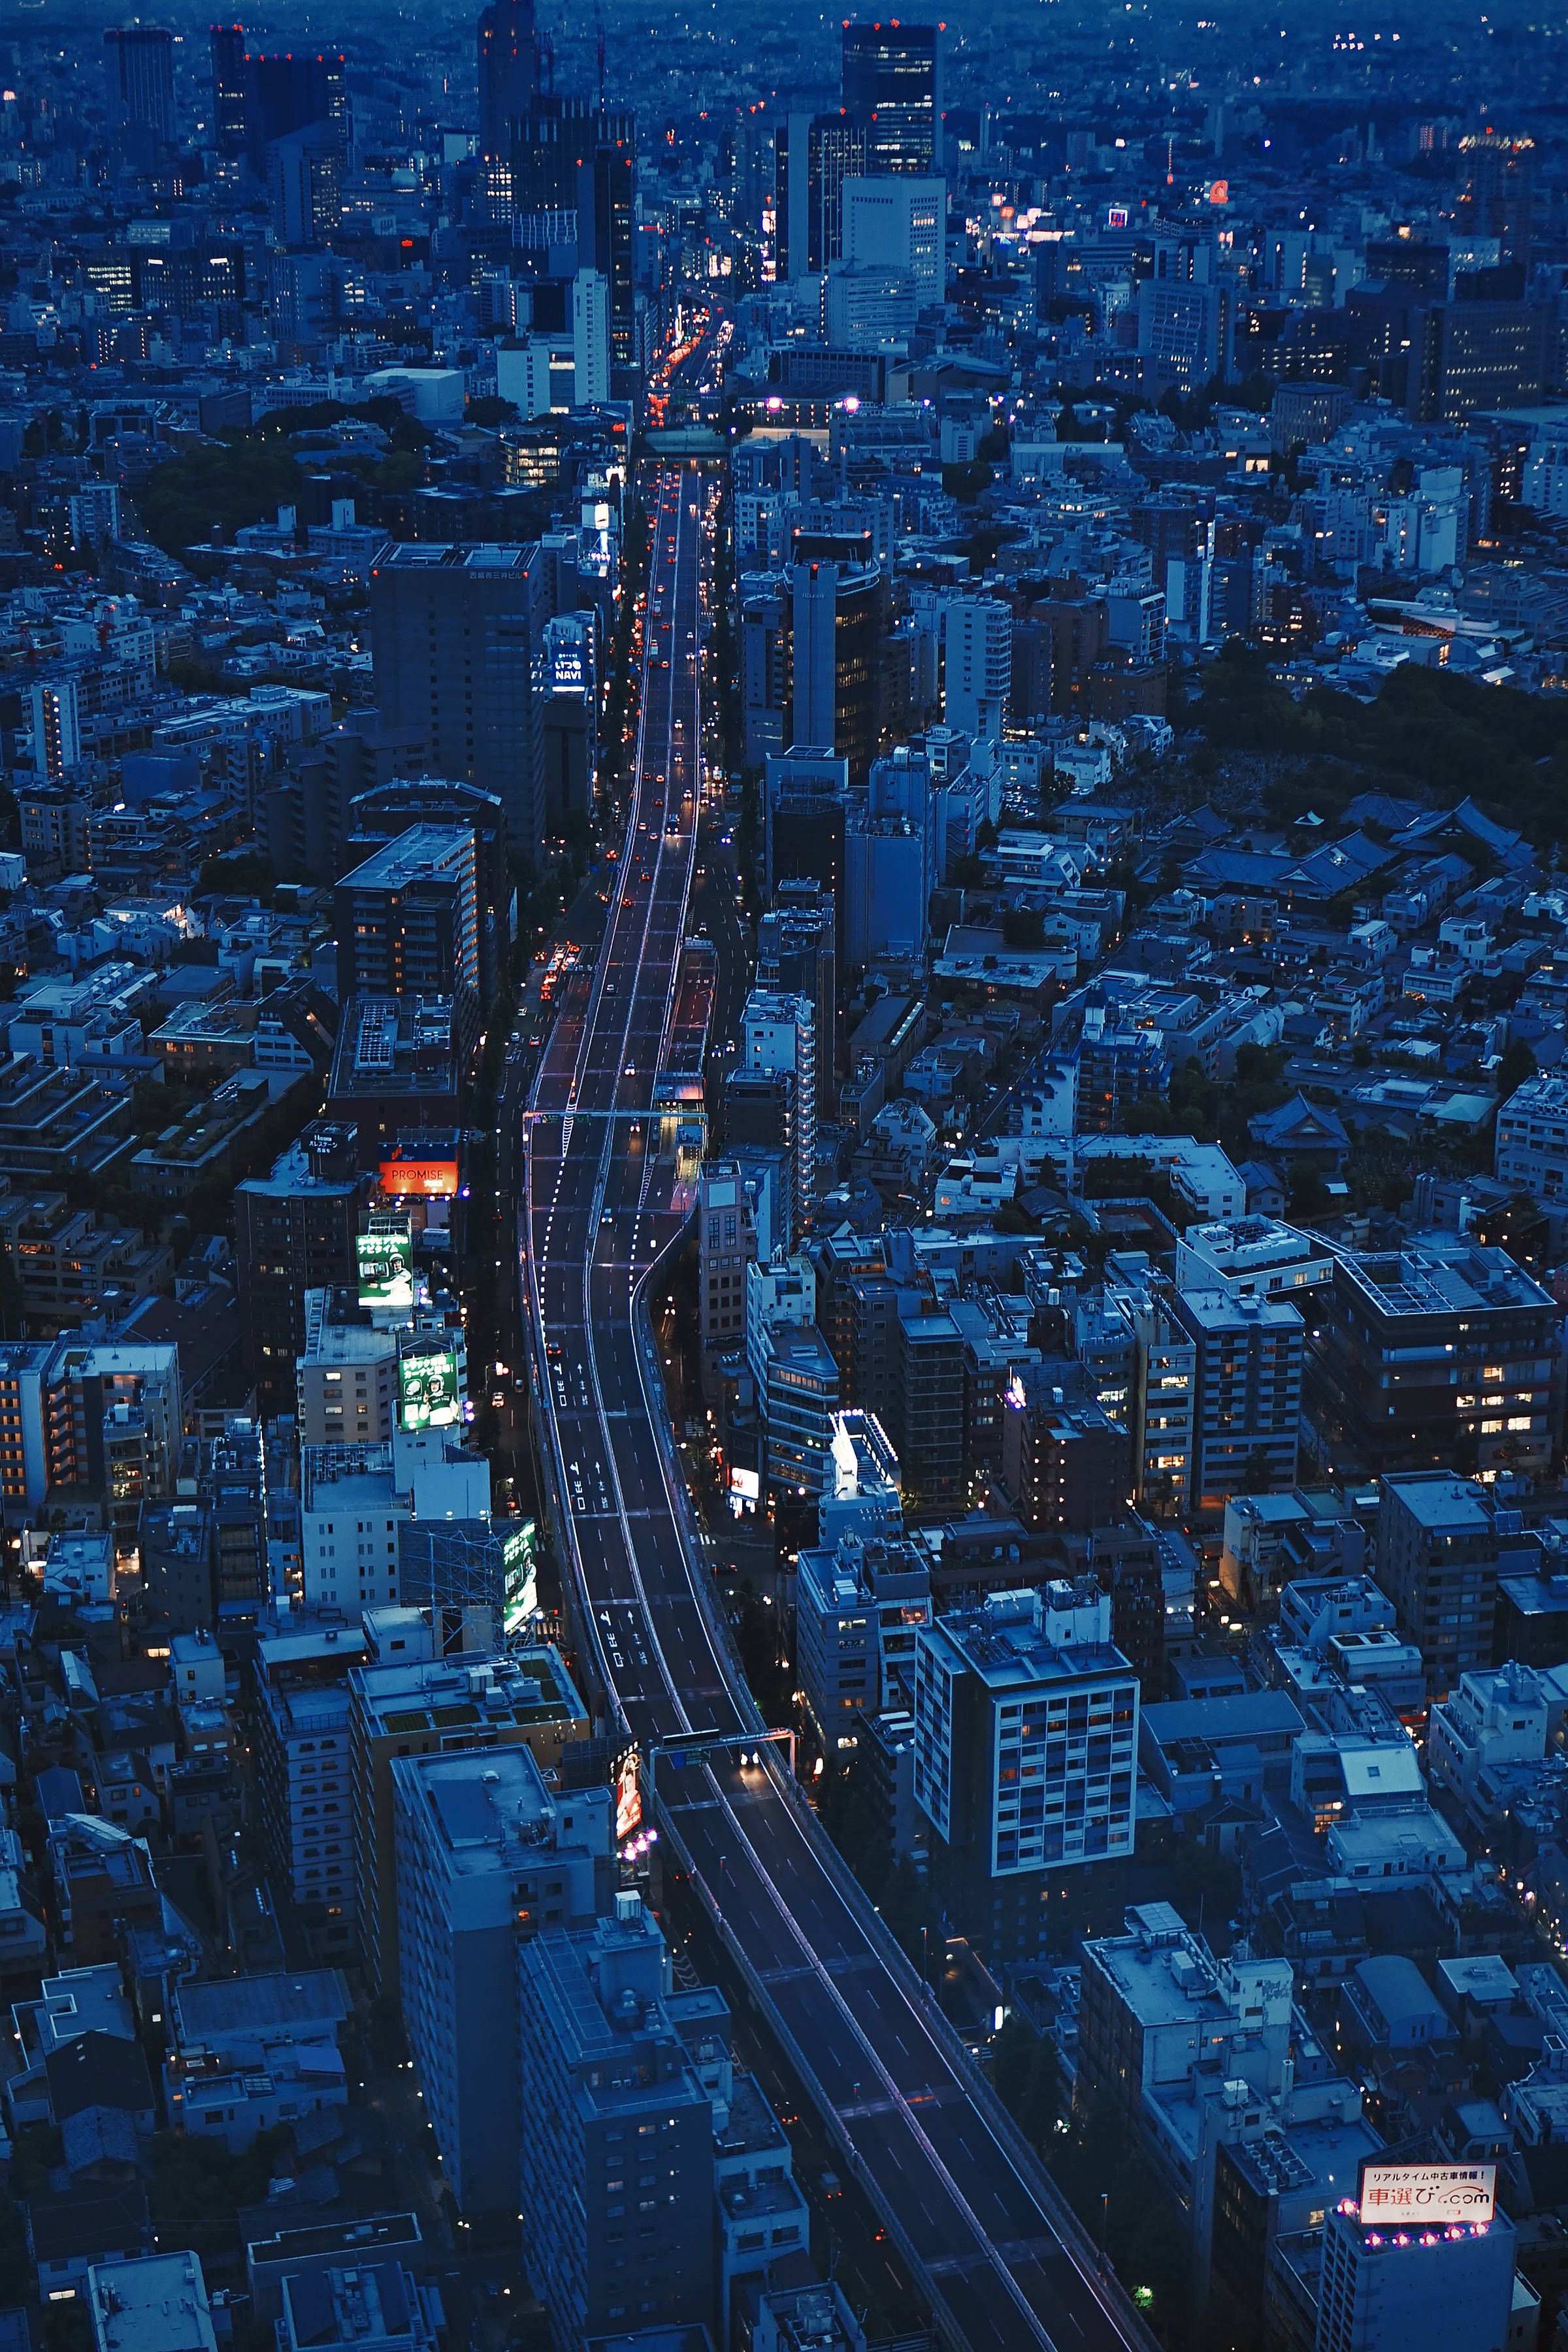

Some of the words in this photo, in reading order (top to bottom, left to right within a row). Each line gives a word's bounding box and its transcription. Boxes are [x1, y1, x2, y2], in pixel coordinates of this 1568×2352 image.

[555, 670, 581, 680] NAVI
[392, 1169, 444, 1181] PROMISE
[358, 1244, 399, 1254] ナビタイム
